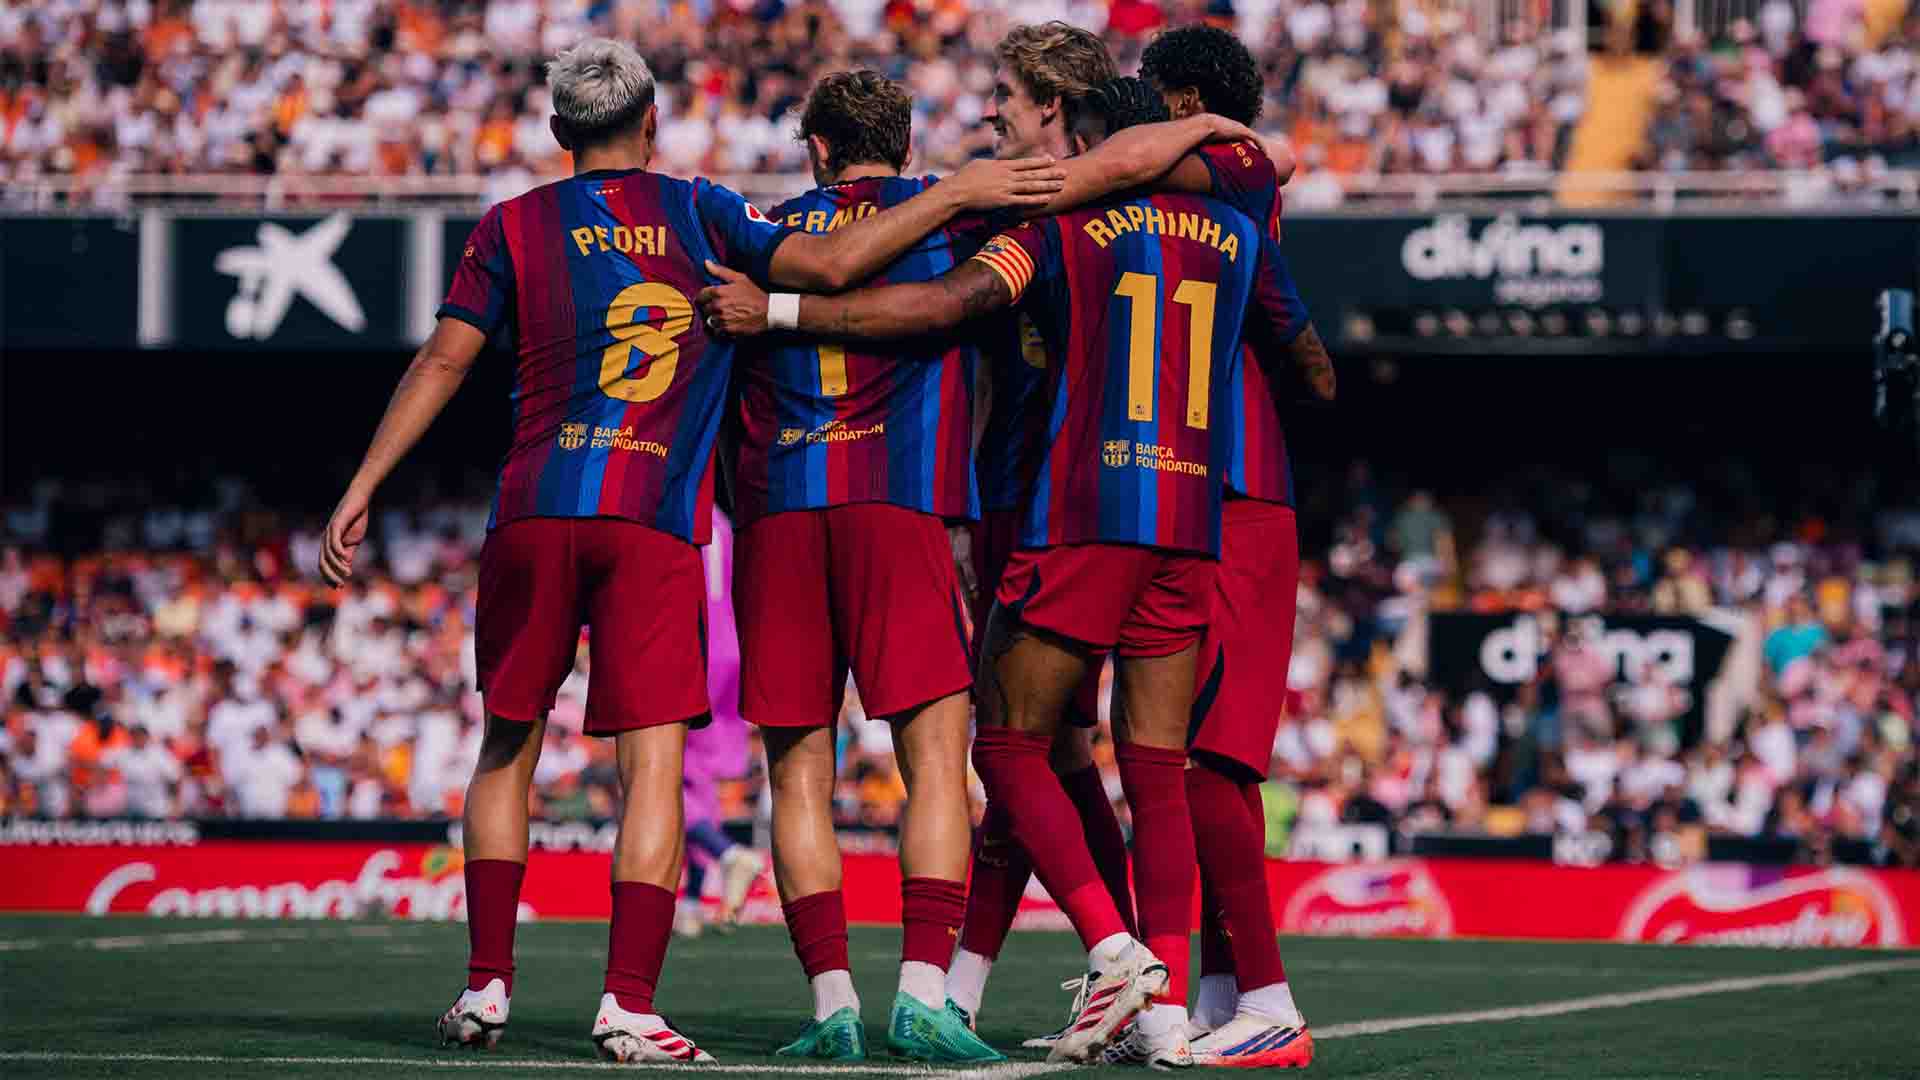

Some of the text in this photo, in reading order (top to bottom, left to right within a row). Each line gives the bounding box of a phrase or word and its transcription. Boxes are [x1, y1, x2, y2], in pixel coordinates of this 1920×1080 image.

[570, 224, 667, 257] PEDRI
[1083, 205, 1240, 263] RAPHINHA
[598, 281, 694, 403] 8
[1114, 271, 1218, 430] 11
[1135, 442, 1175, 459] BARÇA
[1135, 455, 1208, 477] FOUNDATION
